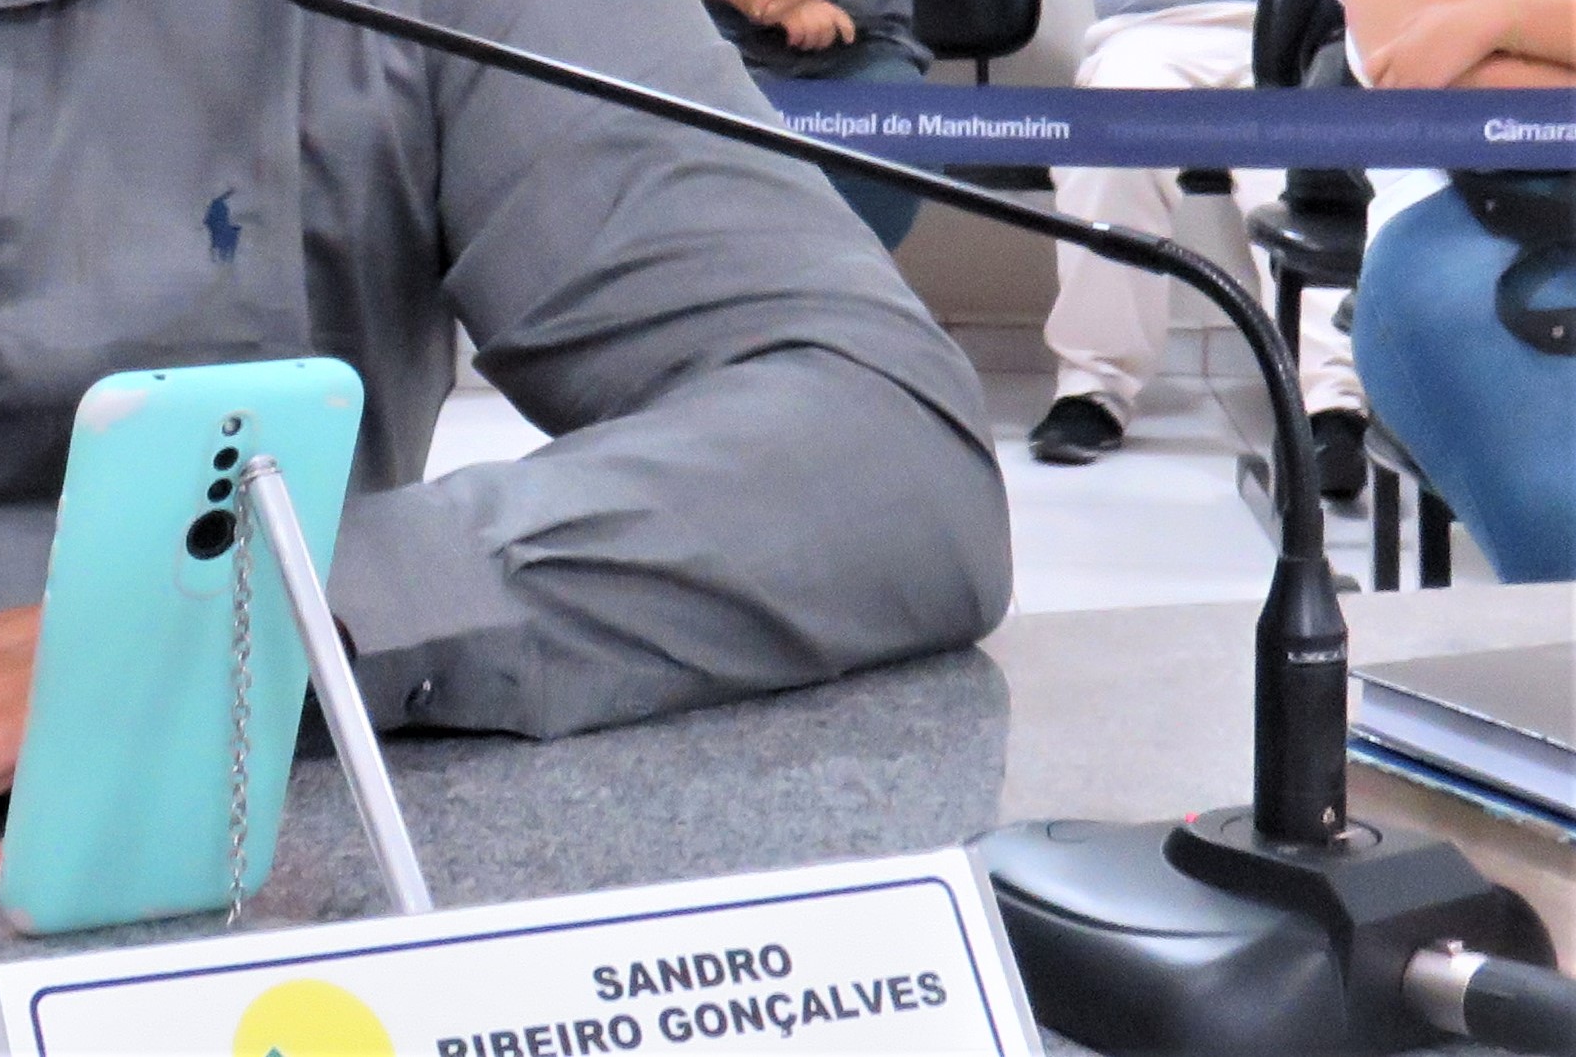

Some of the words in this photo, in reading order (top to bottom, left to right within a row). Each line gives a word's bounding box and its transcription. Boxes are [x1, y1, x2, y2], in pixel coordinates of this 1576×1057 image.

[882, 114, 912, 136] de
[918, 112, 1071, 140] Manhumirim
[592, 942, 793, 1001] SANDRO
[436, 1013, 643, 1057] RIBEIRO
[658, 970, 948, 1043] GONÇALVES
